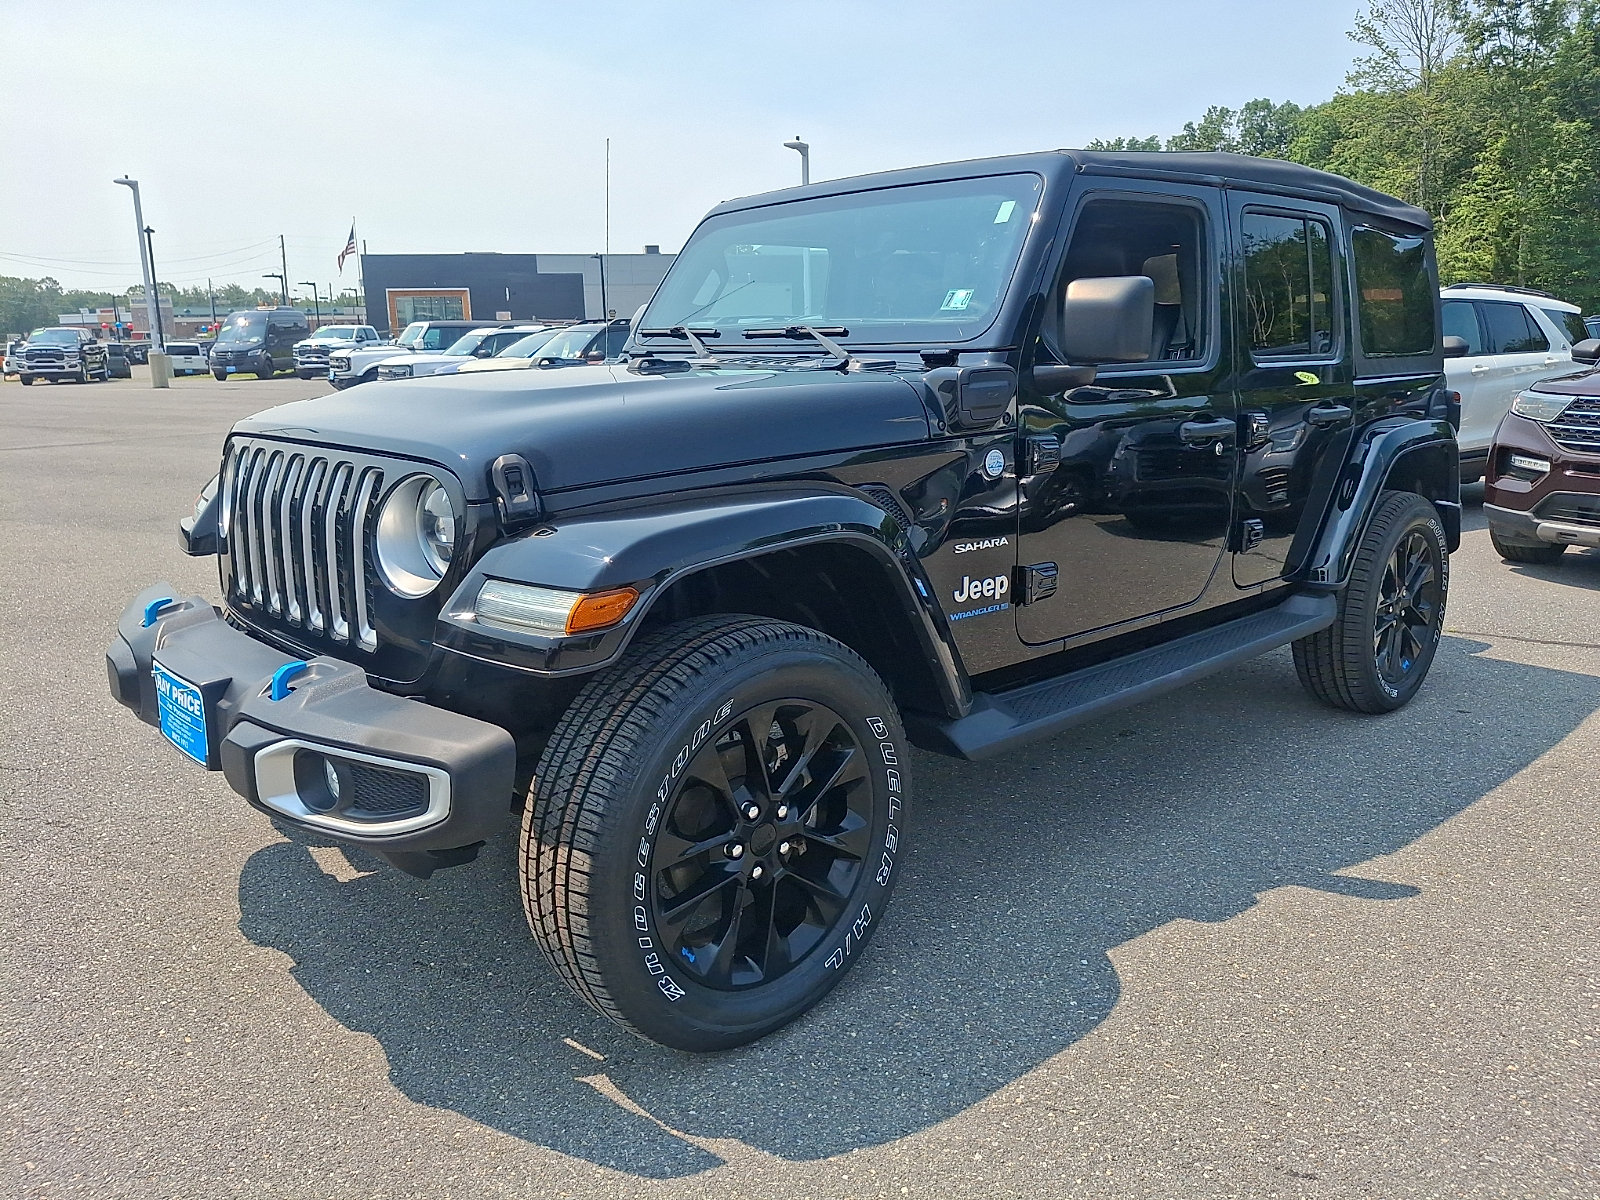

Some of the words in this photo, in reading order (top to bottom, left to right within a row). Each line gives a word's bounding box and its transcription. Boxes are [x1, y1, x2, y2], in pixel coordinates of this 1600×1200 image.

[954, 536, 1009, 554] SAHARA
[1426, 519, 1448, 591] DUELER
[953, 574, 1009, 603] Jeep
[950, 604, 1000, 621] WRANGLER
[172, 686, 201, 716] PRICE
[866, 716, 902, 887] DUELER
[633, 698, 735, 1002] BRIDGESTONE
